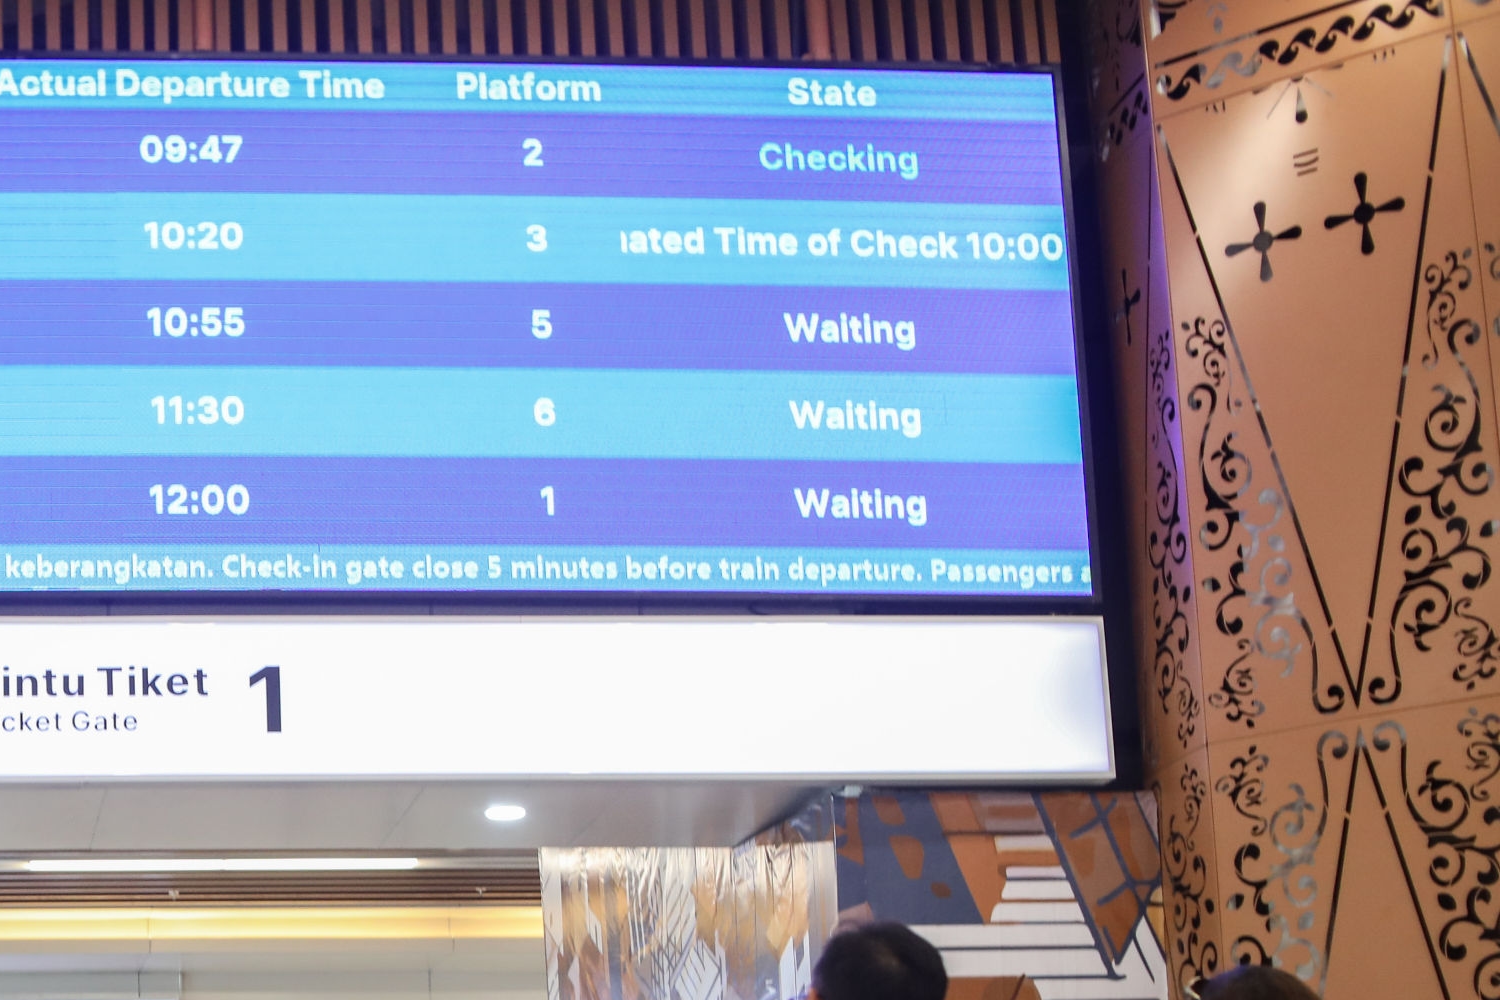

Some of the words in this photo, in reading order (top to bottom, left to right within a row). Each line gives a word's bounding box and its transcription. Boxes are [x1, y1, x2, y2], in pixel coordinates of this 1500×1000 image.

[116, 69, 289, 104] Departure
[299, 70, 384, 98] Time
[457, 73, 601, 101] Platform
[789, 78, 876, 106] State
[140, 135, 242, 162] 09:47
[523, 139, 543, 166] 2
[760, 144, 917, 179] Checking
[145, 222, 243, 249] 10:20
[527, 225, 547, 251] 3
[714, 227, 798, 255] Time
[808, 229, 840, 256] of
[851, 230, 958, 258] Check
[967, 233, 1062, 260] 10:00
[148, 307, 244, 336] 10:55
[532, 310, 552, 338] 5
[784, 313, 915, 350] Waiting
[152, 396, 244, 425] 11:30
[534, 398, 555, 426] 6
[789, 400, 921, 438] Waiting
[150, 485, 249, 514] 12:00
[541, 487, 554, 515] 1
[795, 488, 927, 525] Waiting
[6, 554, 213, 584] keberangkatan.
[223, 554, 336, 577] Check-in
[346, 557, 404, 584] gate
[413, 555, 478, 578] close
[489, 556, 501, 578] 5
[512, 555, 617, 578] minutes
[626, 556, 711, 579] before
[719, 557, 779, 579] train
[789, 557, 922, 586] departure.
[931, 559, 1072, 589] Passengers
[97, 665, 209, 697] Tiket
[249, 665, 283, 733] 1
[72, 711, 138, 732] Gate
